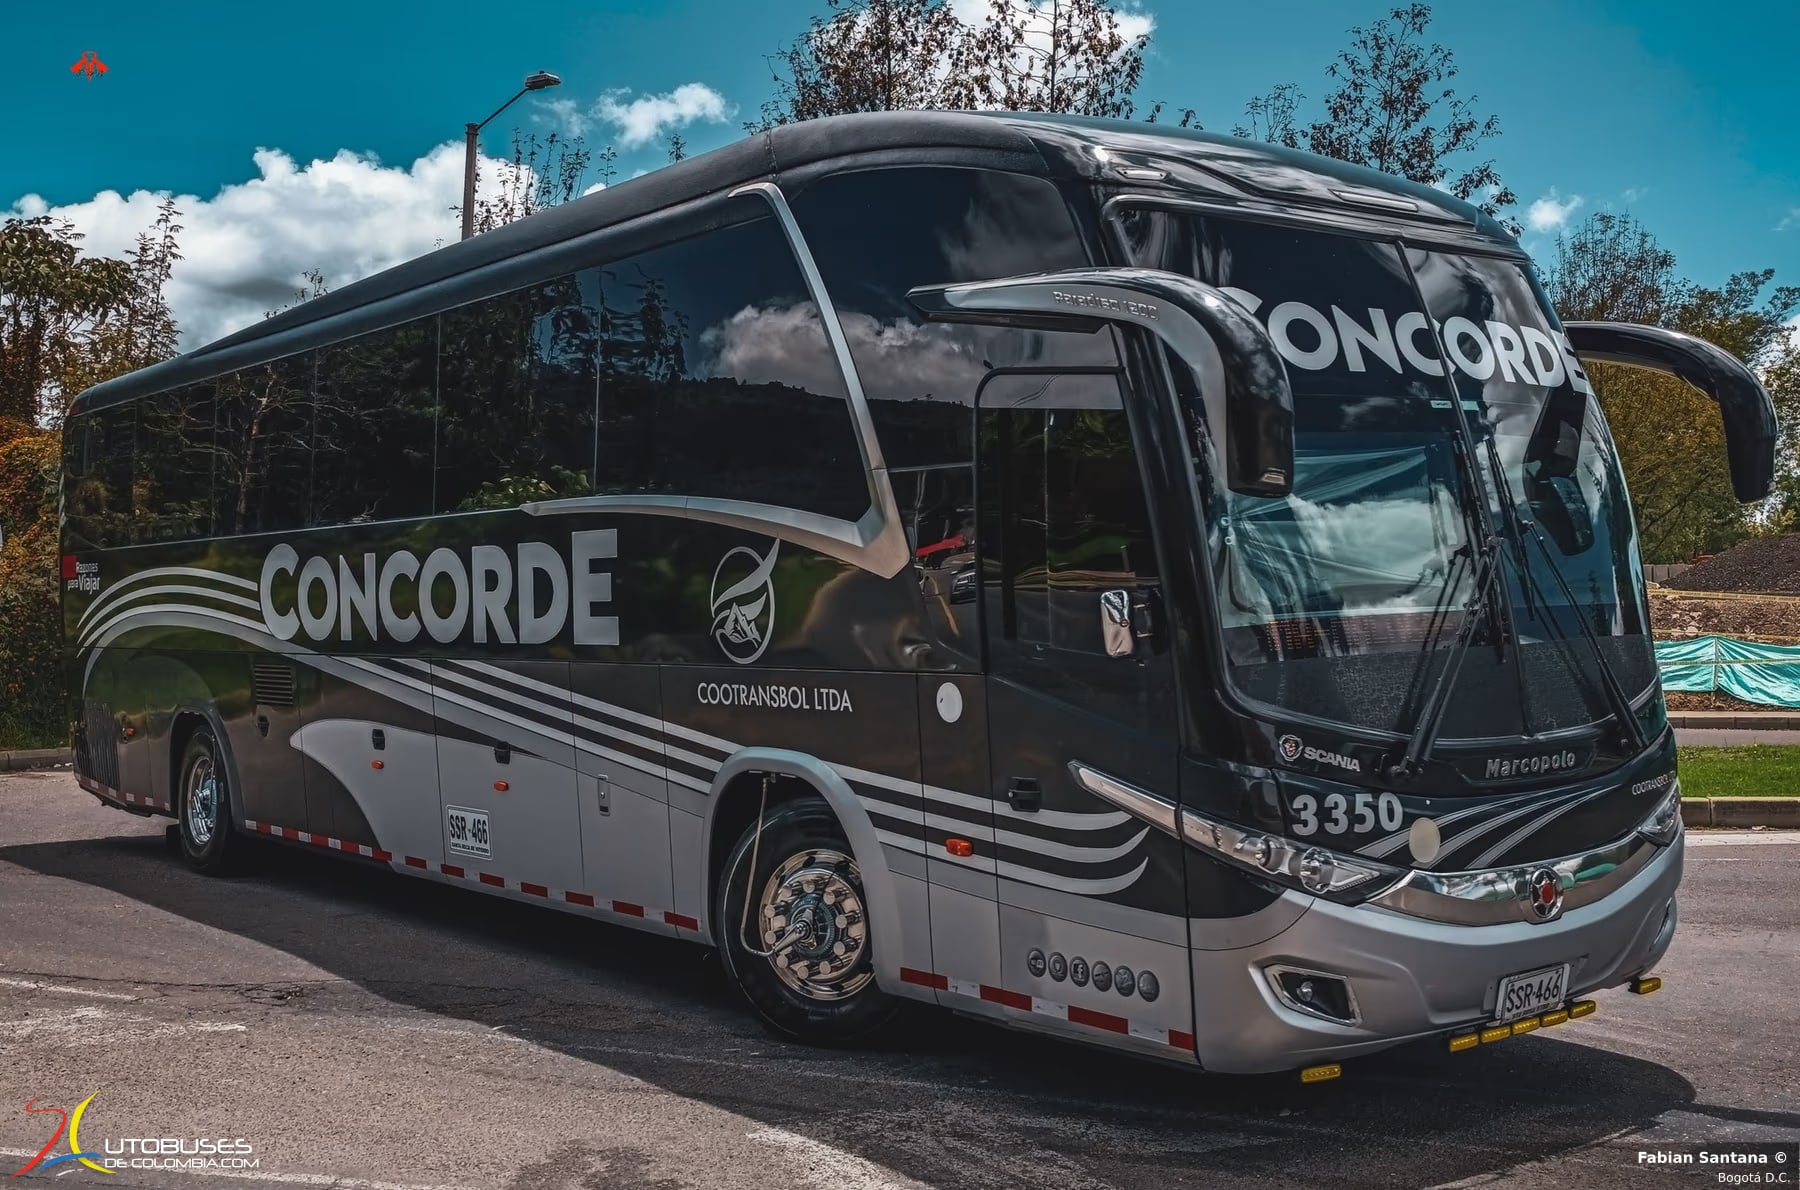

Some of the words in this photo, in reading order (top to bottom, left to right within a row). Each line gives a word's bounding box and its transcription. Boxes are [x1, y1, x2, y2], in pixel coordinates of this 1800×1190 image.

[79, 573, 100, 595] Viajar
[260, 529, 620, 646] CONCORDE
[697, 682, 810, 710] COOTRANSBOL
[814, 687, 853, 713] LTDA
[1303, 746, 1361, 772] SCANIA
[1485, 750, 1576, 779] Marcopolo
[1291, 792, 1404, 836] 3350
